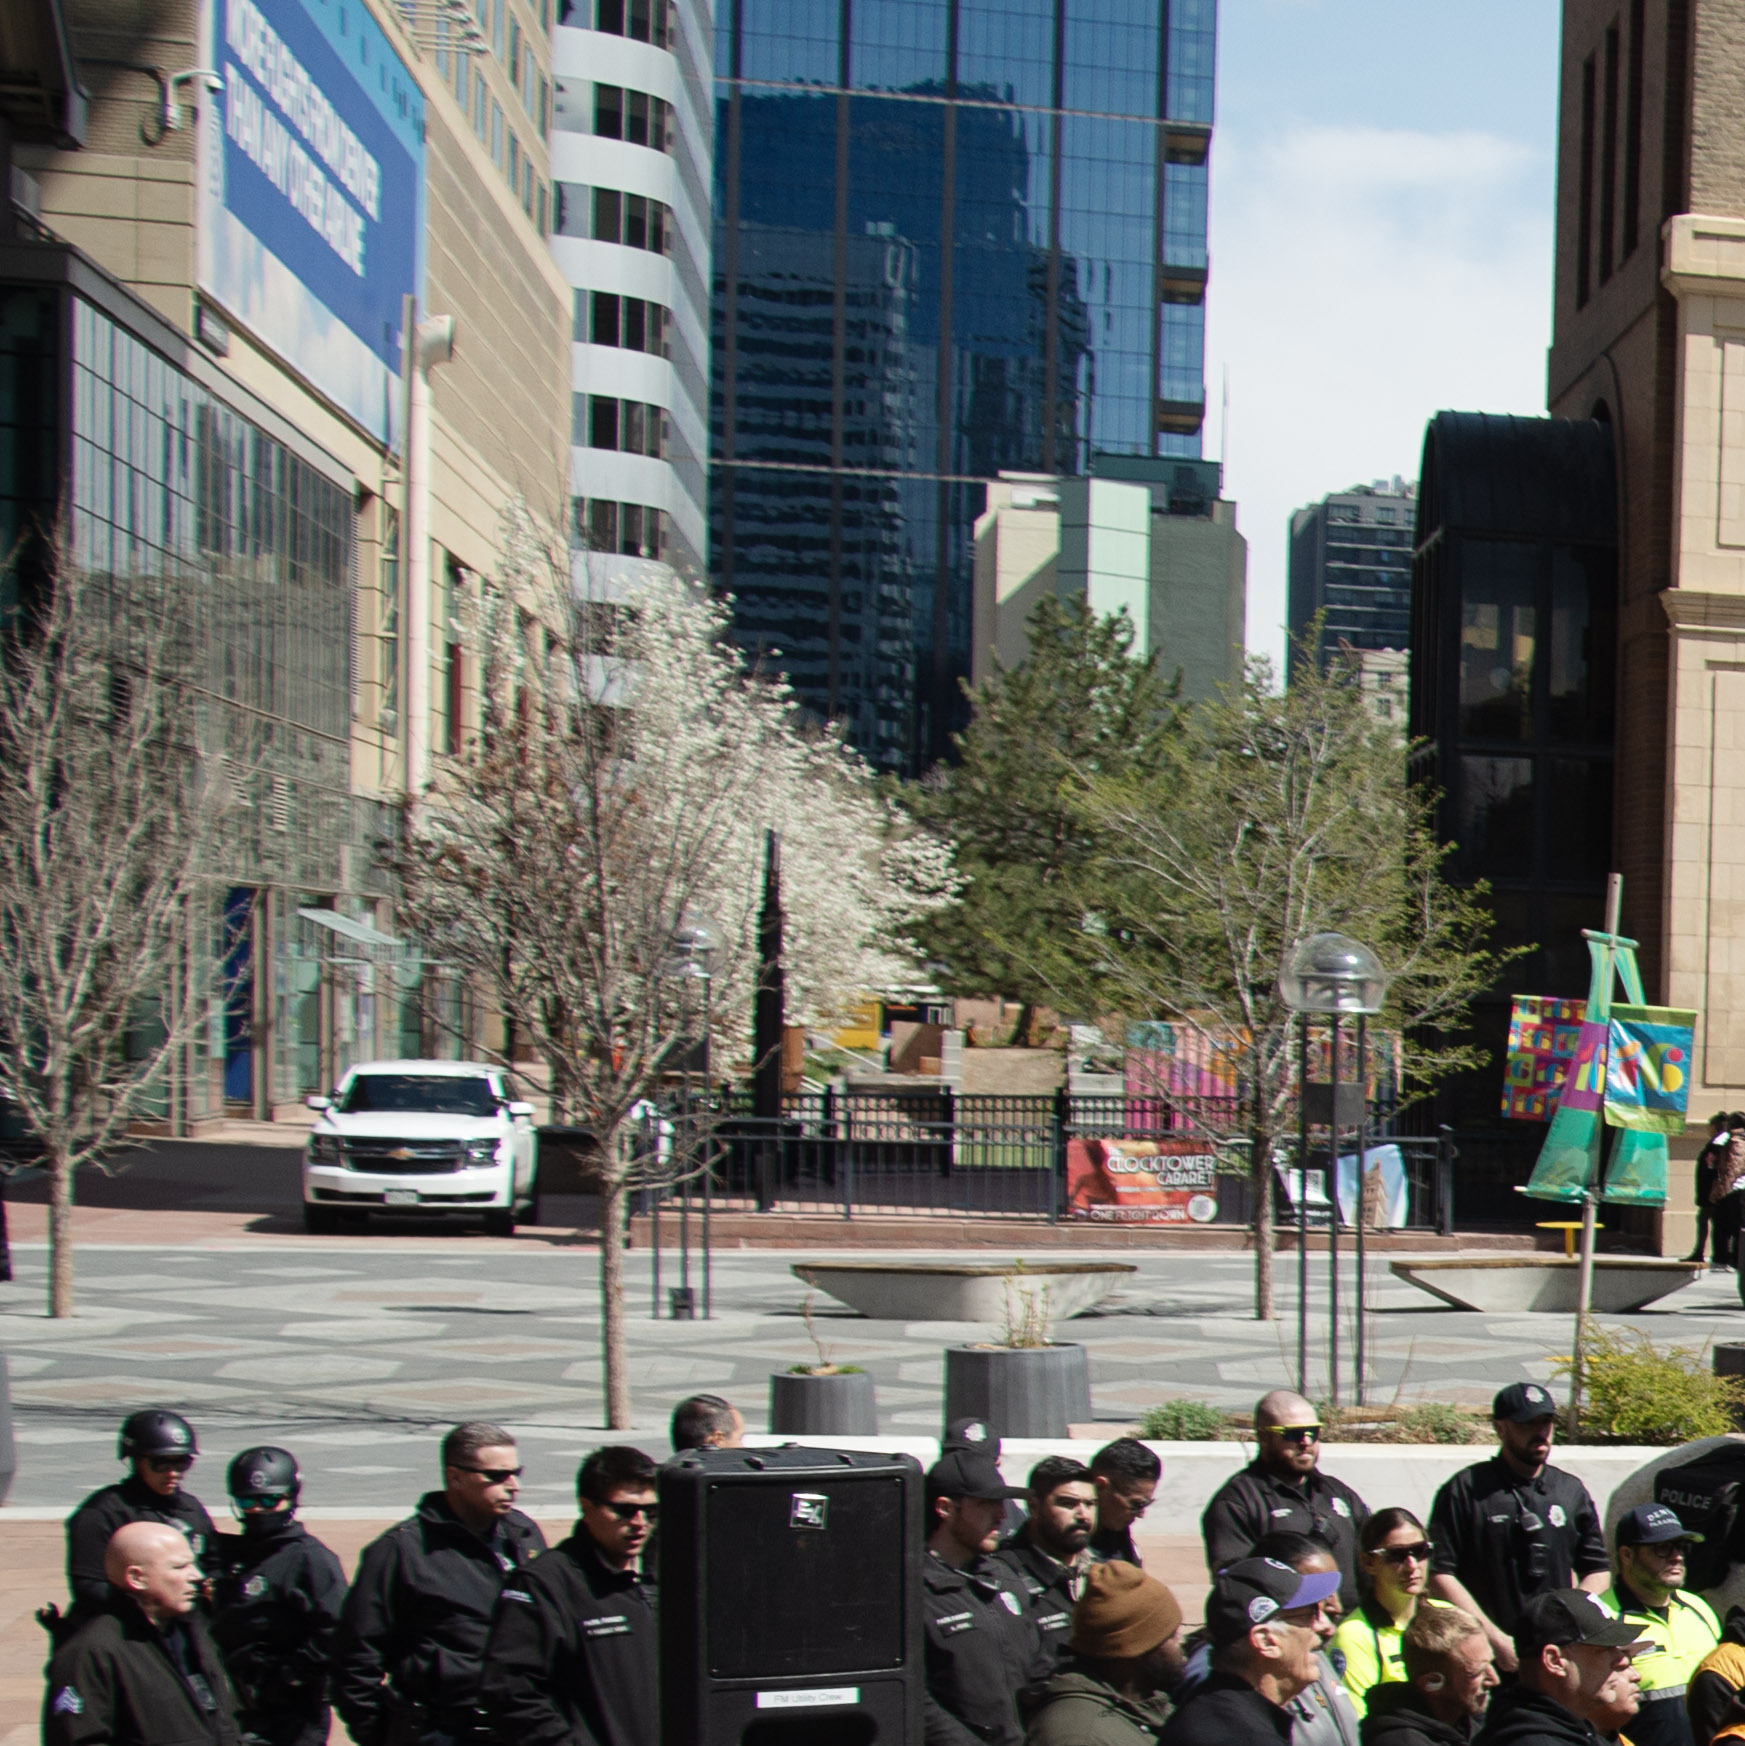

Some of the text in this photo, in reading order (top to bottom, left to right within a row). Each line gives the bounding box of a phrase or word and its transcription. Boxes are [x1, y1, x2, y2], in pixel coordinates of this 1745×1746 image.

[1107, 1155, 1217, 1173] CLOCKTOWER
[1156, 1171, 1215, 1186] CABARET
[1090, 1209, 1114, 1220] ONE
[1660, 1488, 1713, 1510] POLICE
